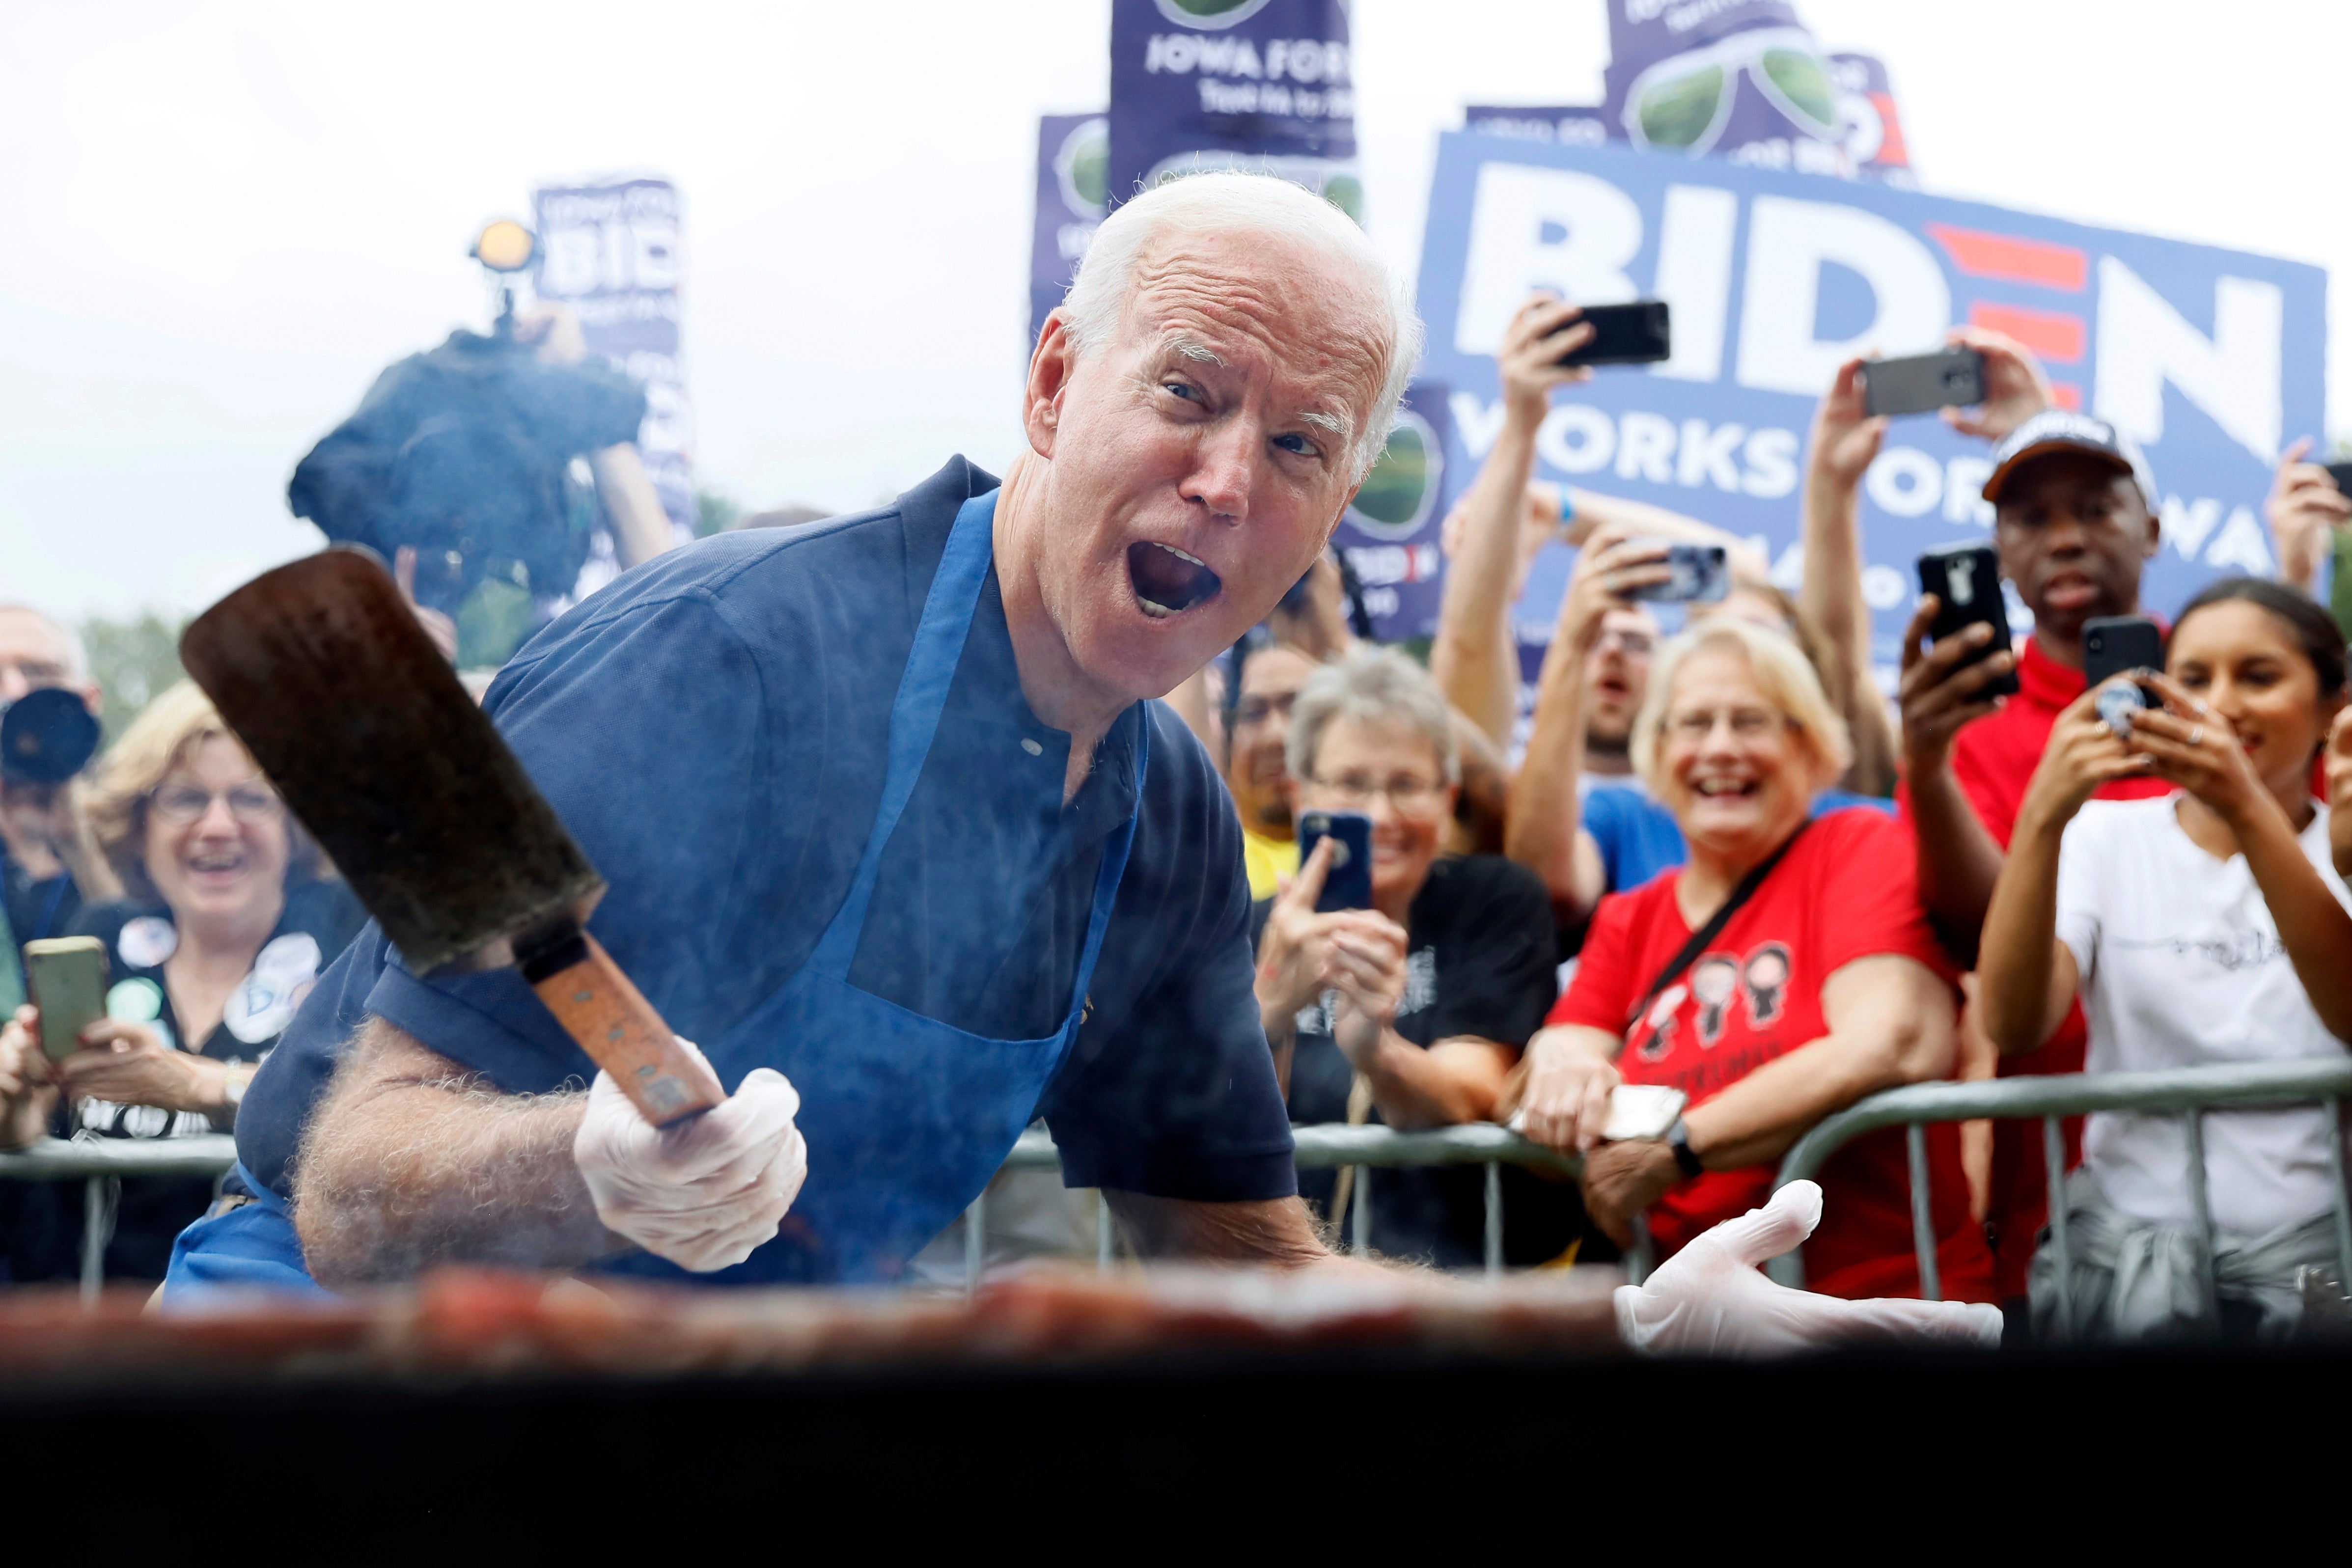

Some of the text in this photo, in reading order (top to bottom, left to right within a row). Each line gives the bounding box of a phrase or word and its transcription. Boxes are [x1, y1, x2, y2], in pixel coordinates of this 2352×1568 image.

[1145, 33, 1263, 80] IOWA
[1454, 160, 2285, 469] BIDEN
[1448, 390, 2278, 578] WORKS OR WA
